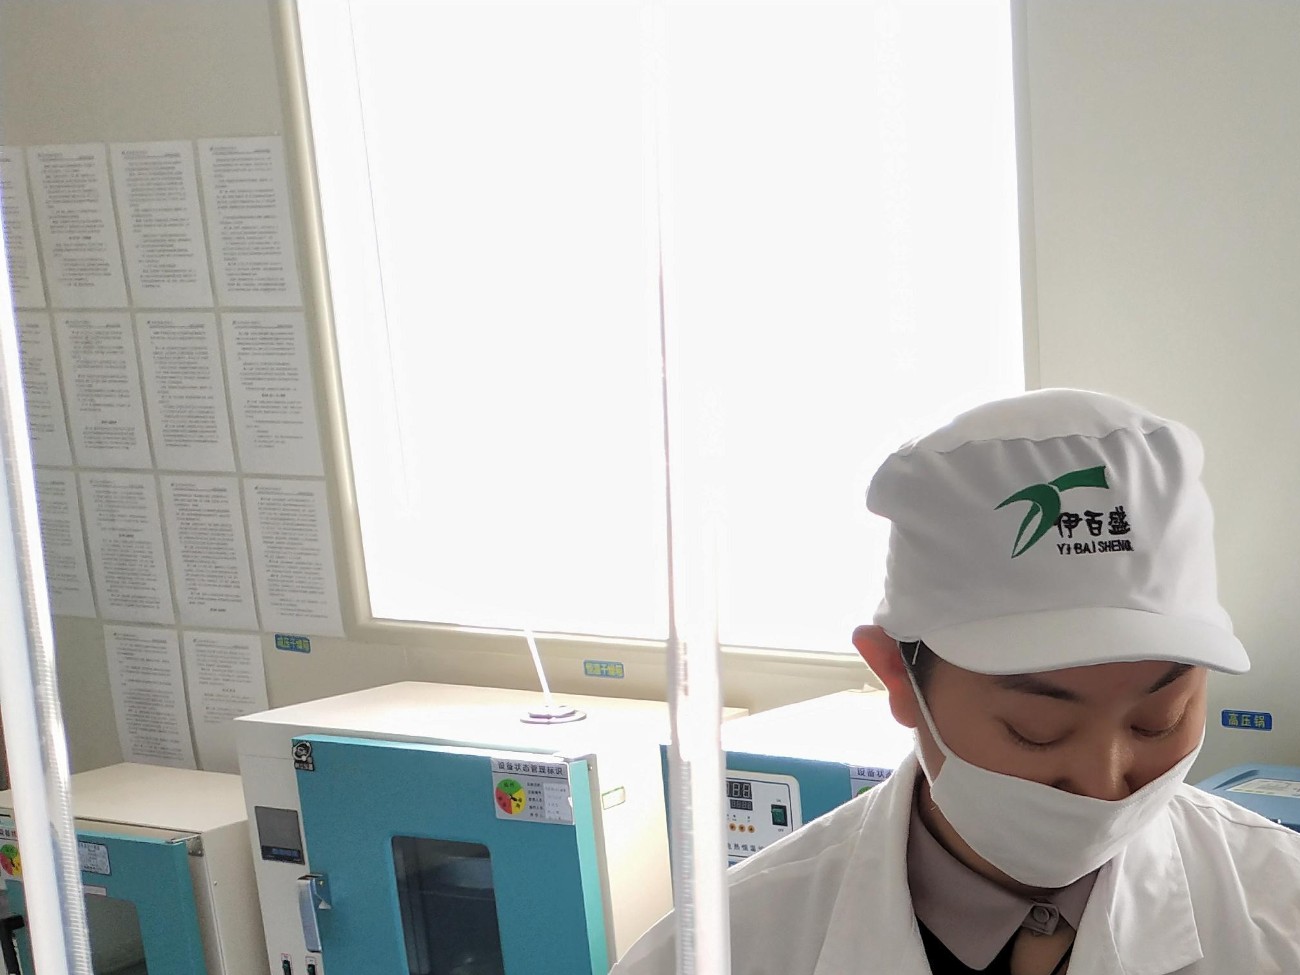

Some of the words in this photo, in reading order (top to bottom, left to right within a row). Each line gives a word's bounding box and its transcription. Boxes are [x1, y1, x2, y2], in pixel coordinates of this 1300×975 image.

[1053, 505, 1131, 539] 伊百盛
[1228, 713, 1266, 729] 高压锅
